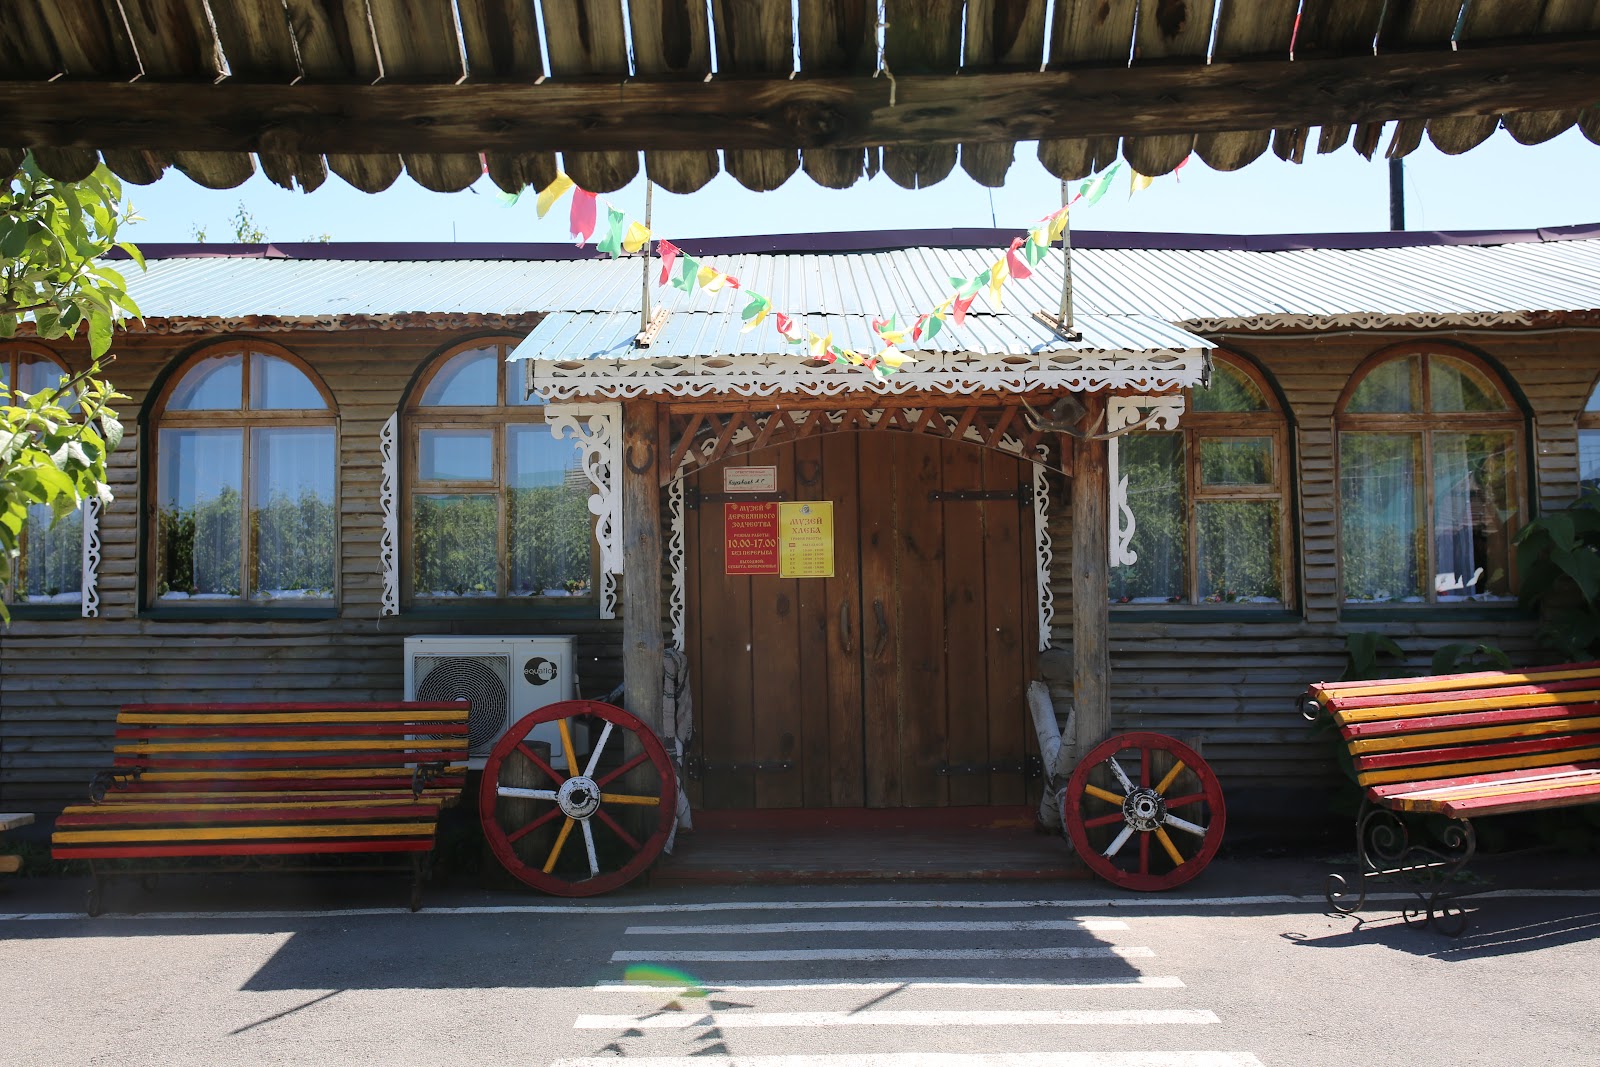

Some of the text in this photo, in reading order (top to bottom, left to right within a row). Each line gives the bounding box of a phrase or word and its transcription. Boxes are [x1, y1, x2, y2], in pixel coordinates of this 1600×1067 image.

[790, 517, 823, 526] МУЗЕЙ
[728, 539, 776, 548] 10.00-17.00
[524, 667, 557, 676] equation
